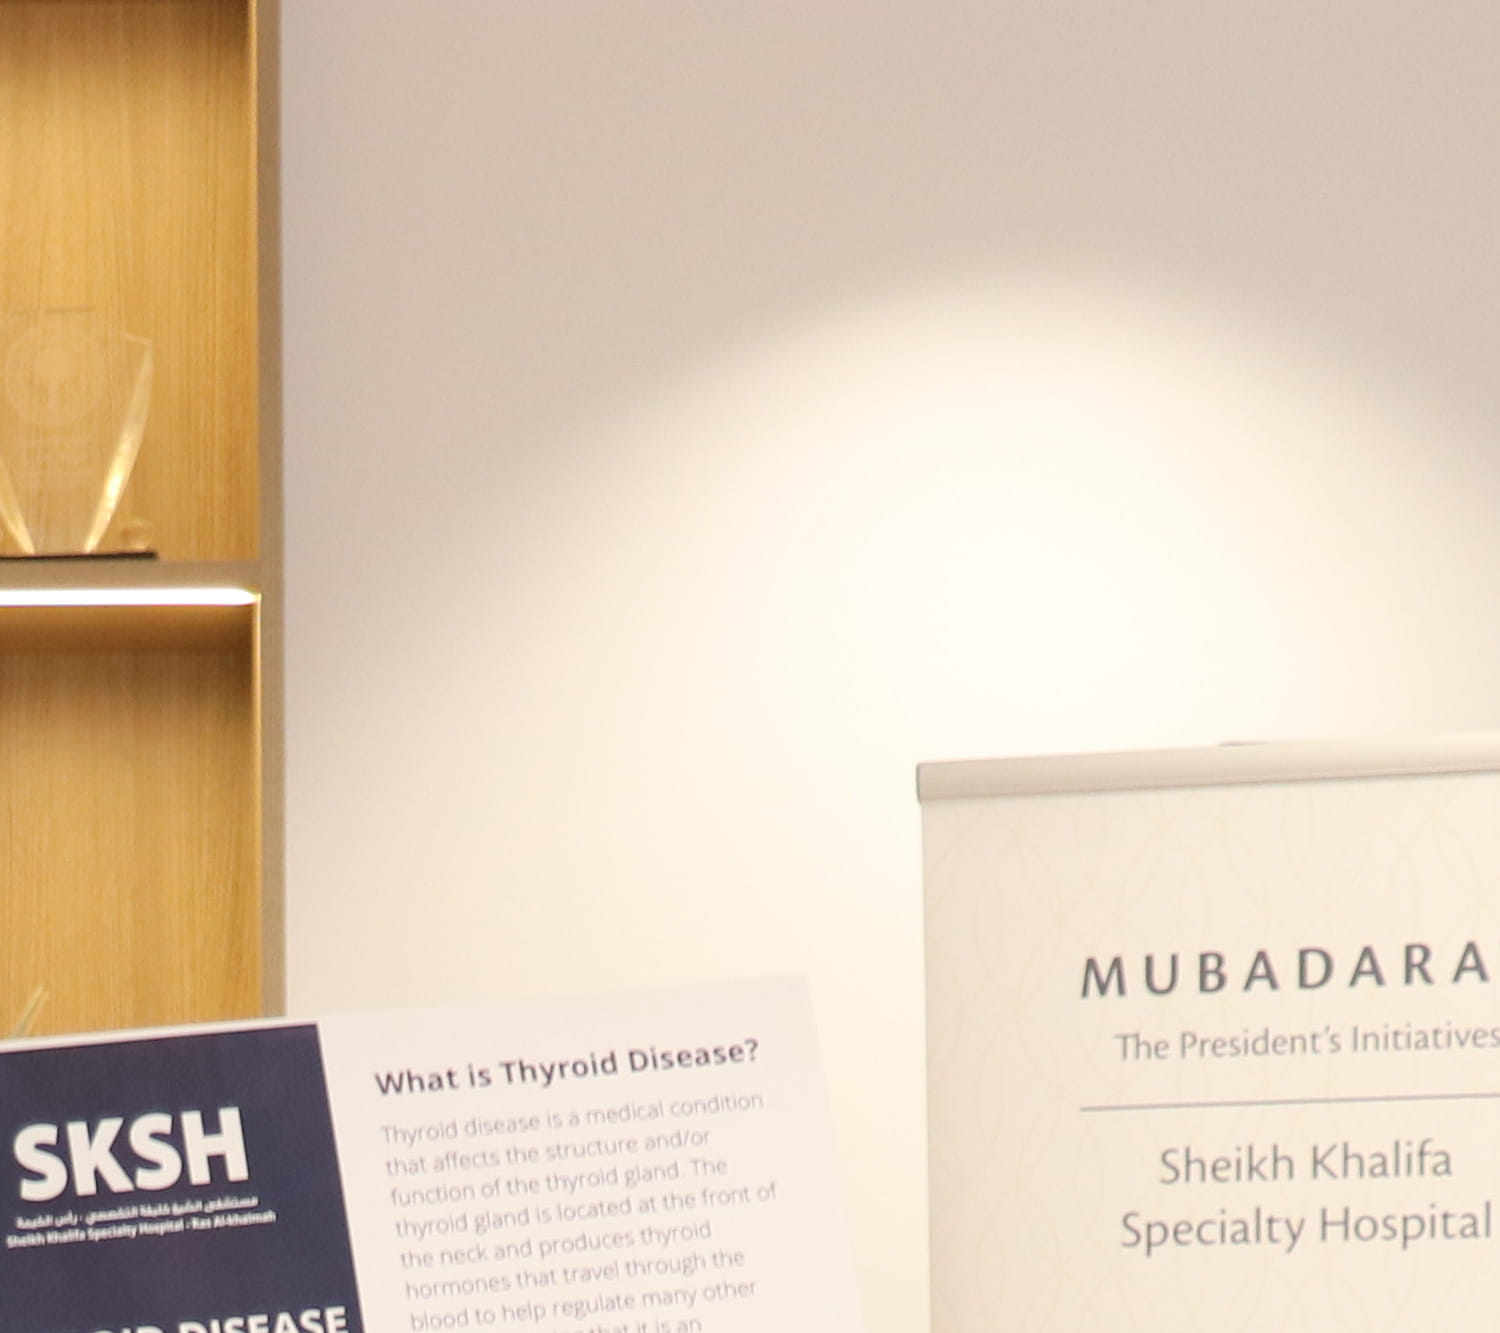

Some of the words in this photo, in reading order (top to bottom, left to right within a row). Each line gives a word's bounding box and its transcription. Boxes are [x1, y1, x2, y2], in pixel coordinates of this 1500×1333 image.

[374, 1068, 458, 1095] What
[467, 1063, 491, 1087] is
[499, 1050, 617, 1087] Thyroid
[628, 1038, 758, 1072] Disease?
[1114, 1032, 1170, 1062] The
[379, 1119, 458, 1147] Thyroid
[463, 1114, 540, 1137] disease
[546, 1111, 563, 1129] is
[568, 1111, 580, 1127] a
[585, 1099, 664, 1124] medical
[669, 1094, 763, 1117] condition
[13, 1106, 248, 1201] SKSH
[384, 1155, 427, 1176] that
[432, 1149, 500, 1173] affects
[504, 1144, 539, 1165] the
[544, 1138, 637, 1161] structure
[644, 1128, 709, 1151] and/or
[1160, 1145, 1294, 1185] Sheikh
[1311, 1139, 1453, 1180] Khalifa
[389, 1183, 475, 1207] function
[480, 1176, 500, 1199] of
[505, 1175, 540, 1195] the
[544, 1165, 618, 1195] thyroid
[623, 1159, 685, 1189] gland.
[688, 1157, 727, 1175] The
[394, 1211, 468, 1241] thyroid
[473, 1206, 530, 1235] gland
[535, 1206, 552, 1223] is
[556, 1195, 632, 1221] located
[637, 1195, 656, 1213] at
[661, 1191, 695, 1211] the
[700, 1186, 750, 1205] front
[756, 1180, 775, 1201] of
[1120, 1209, 1305, 1258] Specialty
[1320, 1201, 1494, 1252] Hospital
[399, 1249, 434, 1269] the
[439, 1242, 488, 1265] neck
[493, 1237, 532, 1260] and
[538, 1231, 635, 1260] produces
[639, 1219, 711, 1248] thyroid
[404, 1274, 511, 1300] hormones
[514, 1268, 558, 1289] that
[561, 1259, 619, 1284] travel
[623, 1251, 706, 1277] through
[710, 1248, 744, 1268] the
[409, 1306, 469, 1332] blood
[473, 1307, 496, 1325] to
[501, 1299, 546, 1324] help
[551, 1292, 635, 1320] regulate
[641, 1288, 697, 1308] many
[702, 1280, 755, 1301] other
